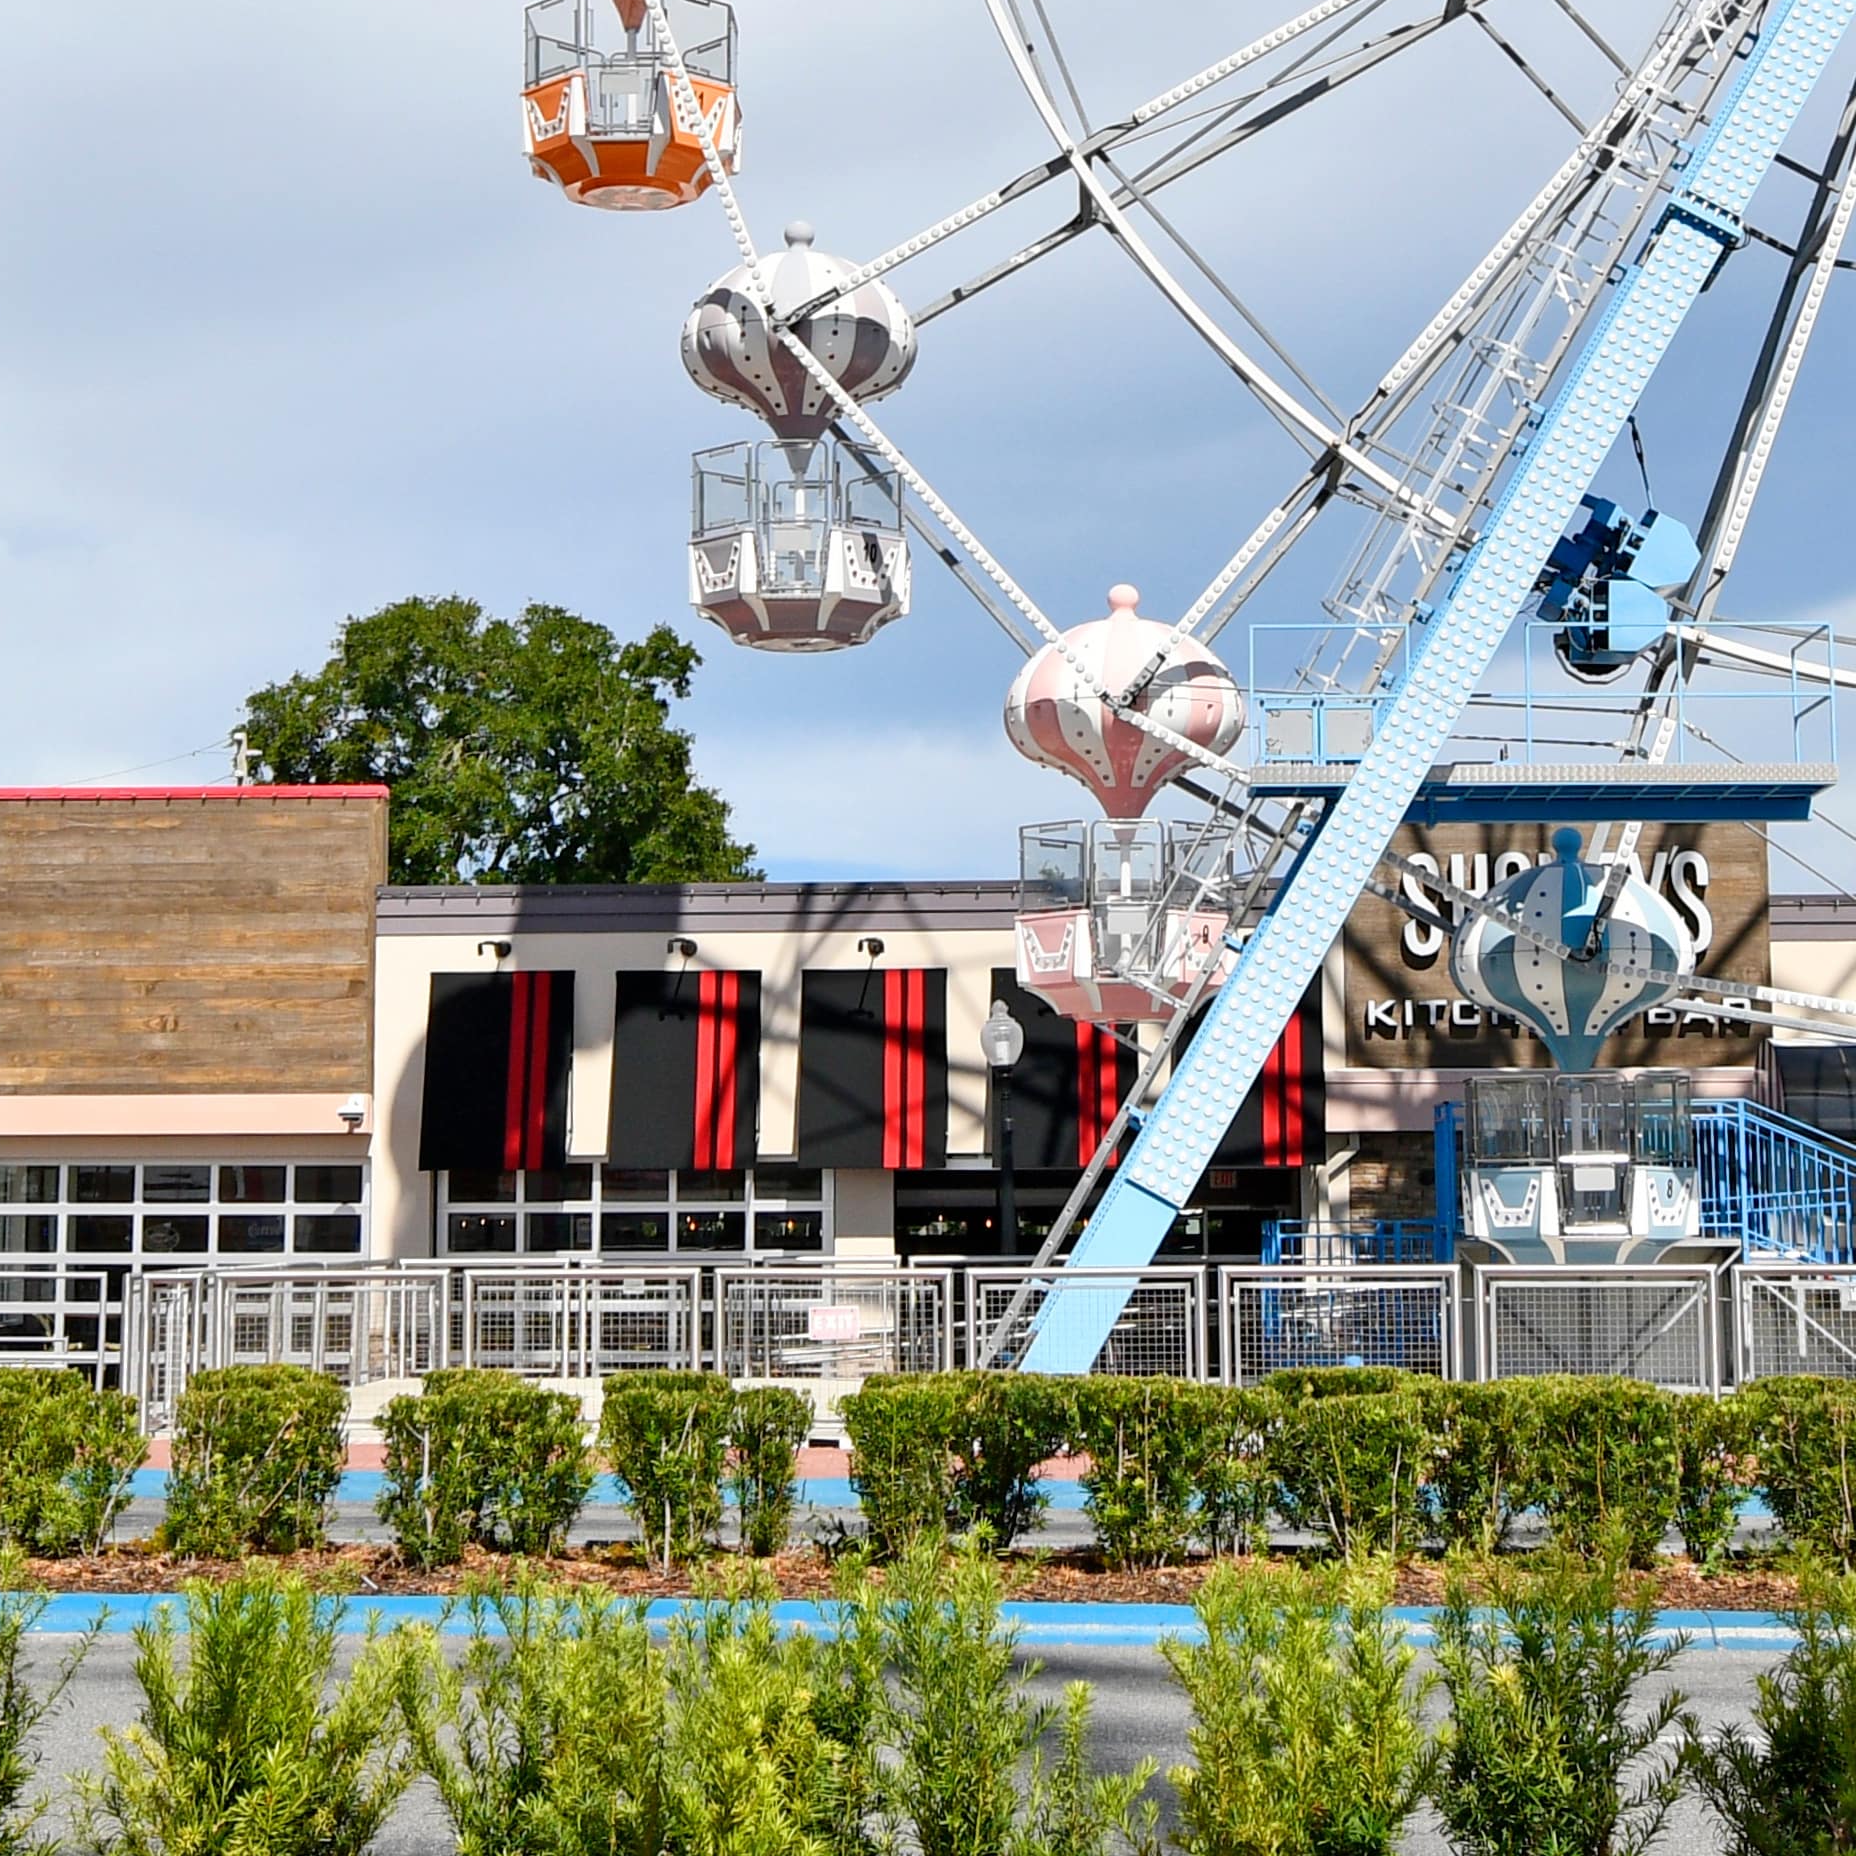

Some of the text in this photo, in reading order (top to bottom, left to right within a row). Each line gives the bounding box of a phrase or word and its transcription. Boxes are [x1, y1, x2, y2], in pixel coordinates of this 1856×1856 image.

[863, 542, 878, 564] 10
[1202, 924, 1210, 945] 9
[1666, 1178, 1673, 1199] 8
[814, 1315, 853, 1329] EXIT
